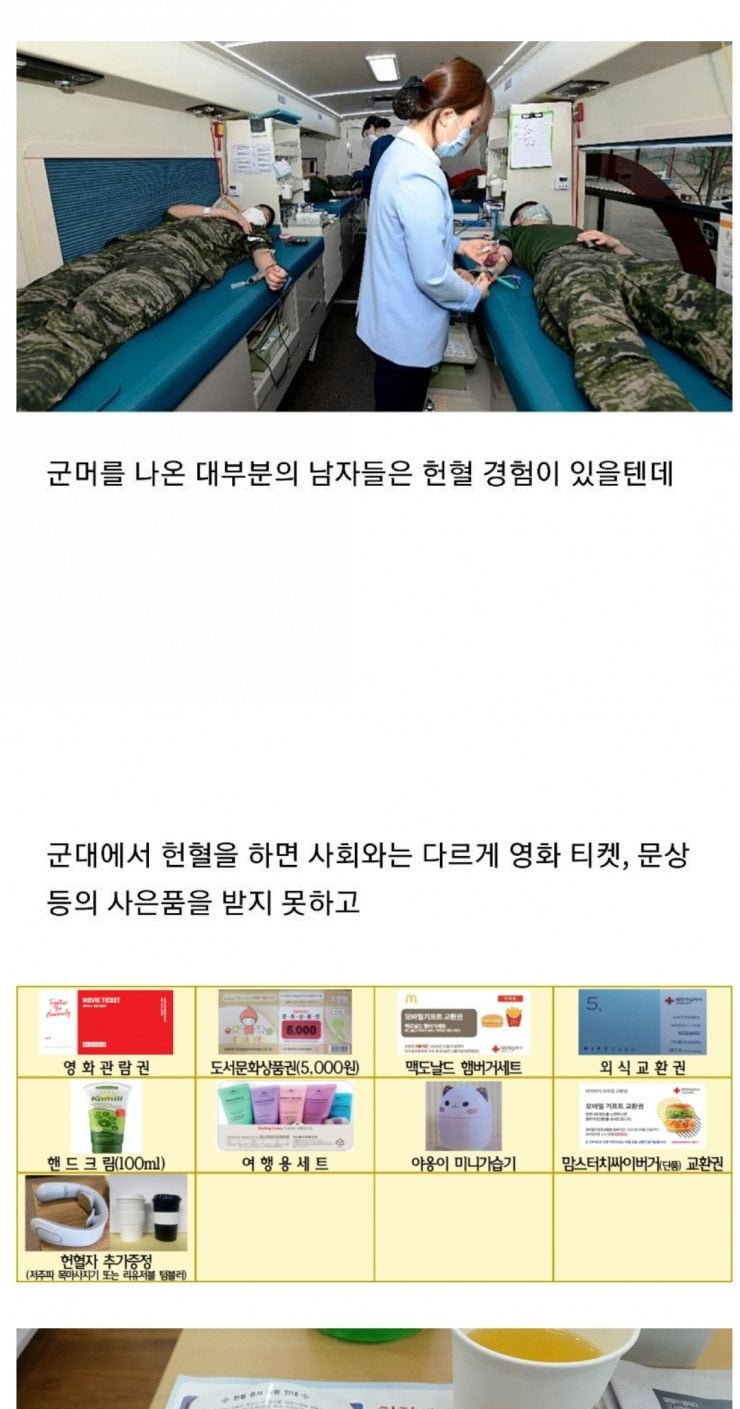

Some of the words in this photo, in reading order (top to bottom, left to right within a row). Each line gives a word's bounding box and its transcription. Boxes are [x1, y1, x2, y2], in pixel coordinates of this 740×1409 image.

[405, 1060, 455, 1076] 맥도날드
[461, 1060, 522, 1076] 햄버거세트
[411, 1156, 449, 1172] 야옹이
[455, 1156, 516, 1172] 미니가습기
[686, 1156, 723, 1172] 교환권
[60, 1254, 98, 1270] 헌혈자
[103, 1254, 152, 1270] 추가증정
